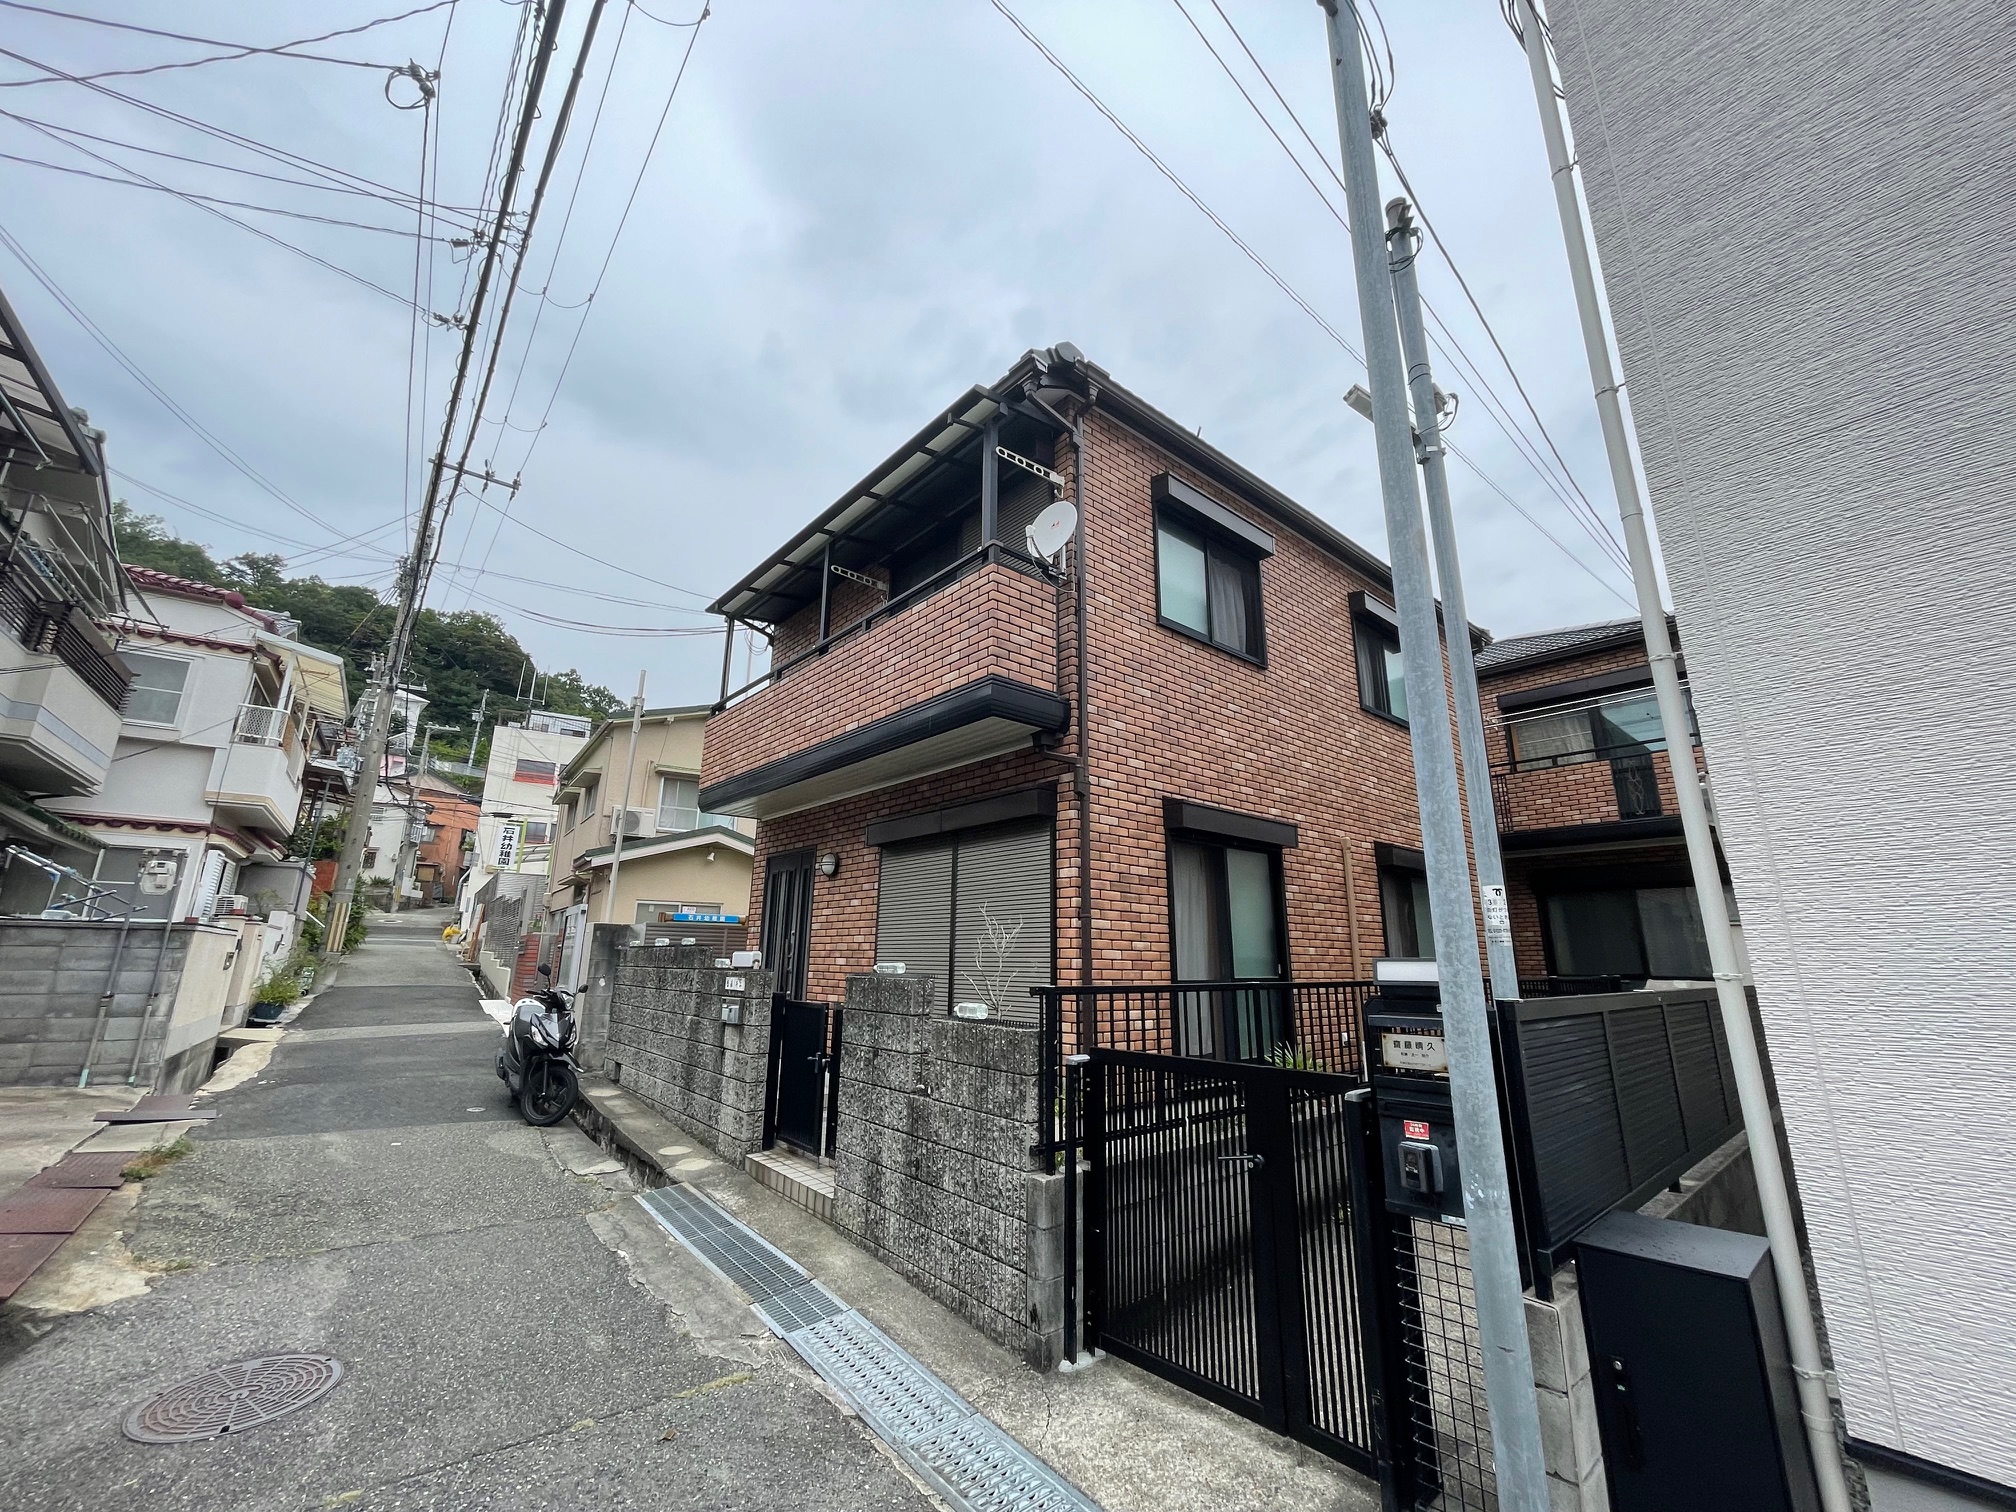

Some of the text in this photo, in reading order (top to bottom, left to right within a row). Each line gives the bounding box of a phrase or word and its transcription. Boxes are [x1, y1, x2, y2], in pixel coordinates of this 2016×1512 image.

[498, 827, 516, 865] 石井幼稚園
